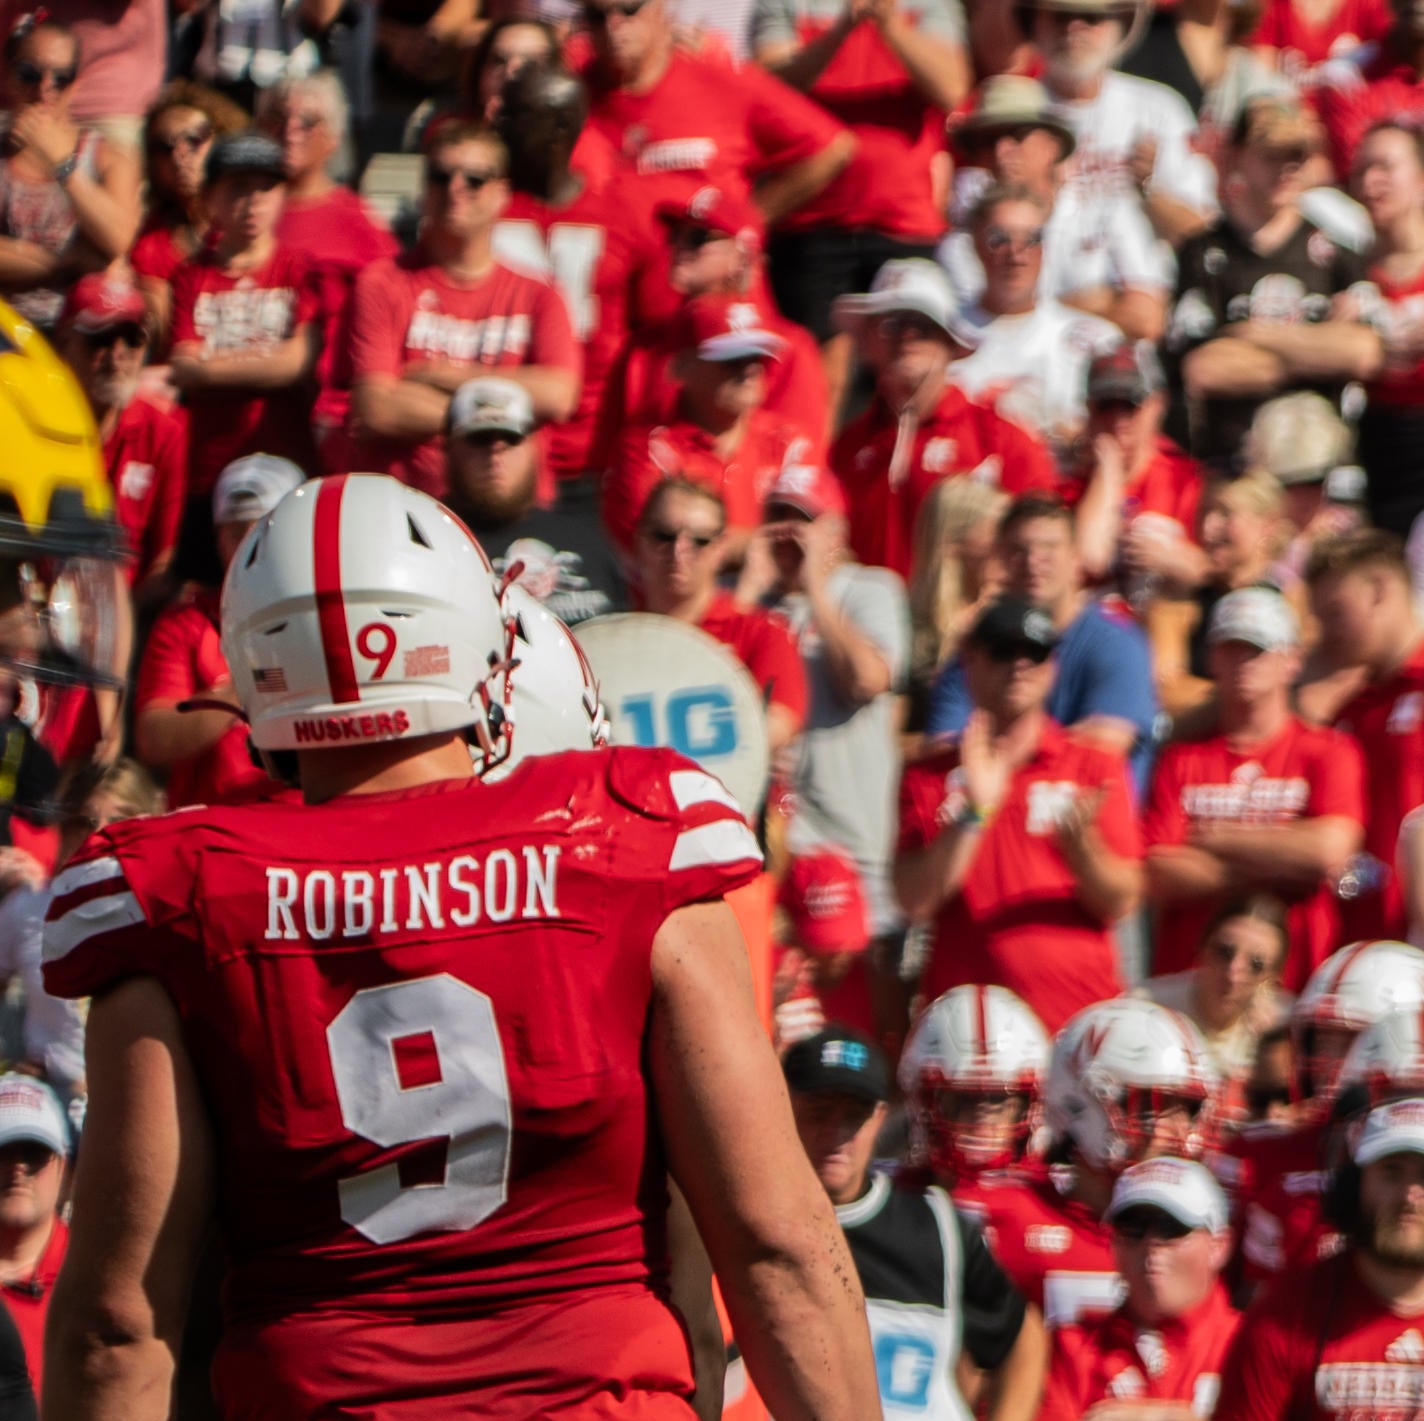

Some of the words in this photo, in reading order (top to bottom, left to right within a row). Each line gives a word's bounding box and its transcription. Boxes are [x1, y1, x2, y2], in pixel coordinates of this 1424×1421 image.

[355, 622, 398, 681] 9
[294, 710, 411, 743] HUSKERS
[264, 845, 561, 940] ROBINSON
[326, 973, 513, 1245] 9
